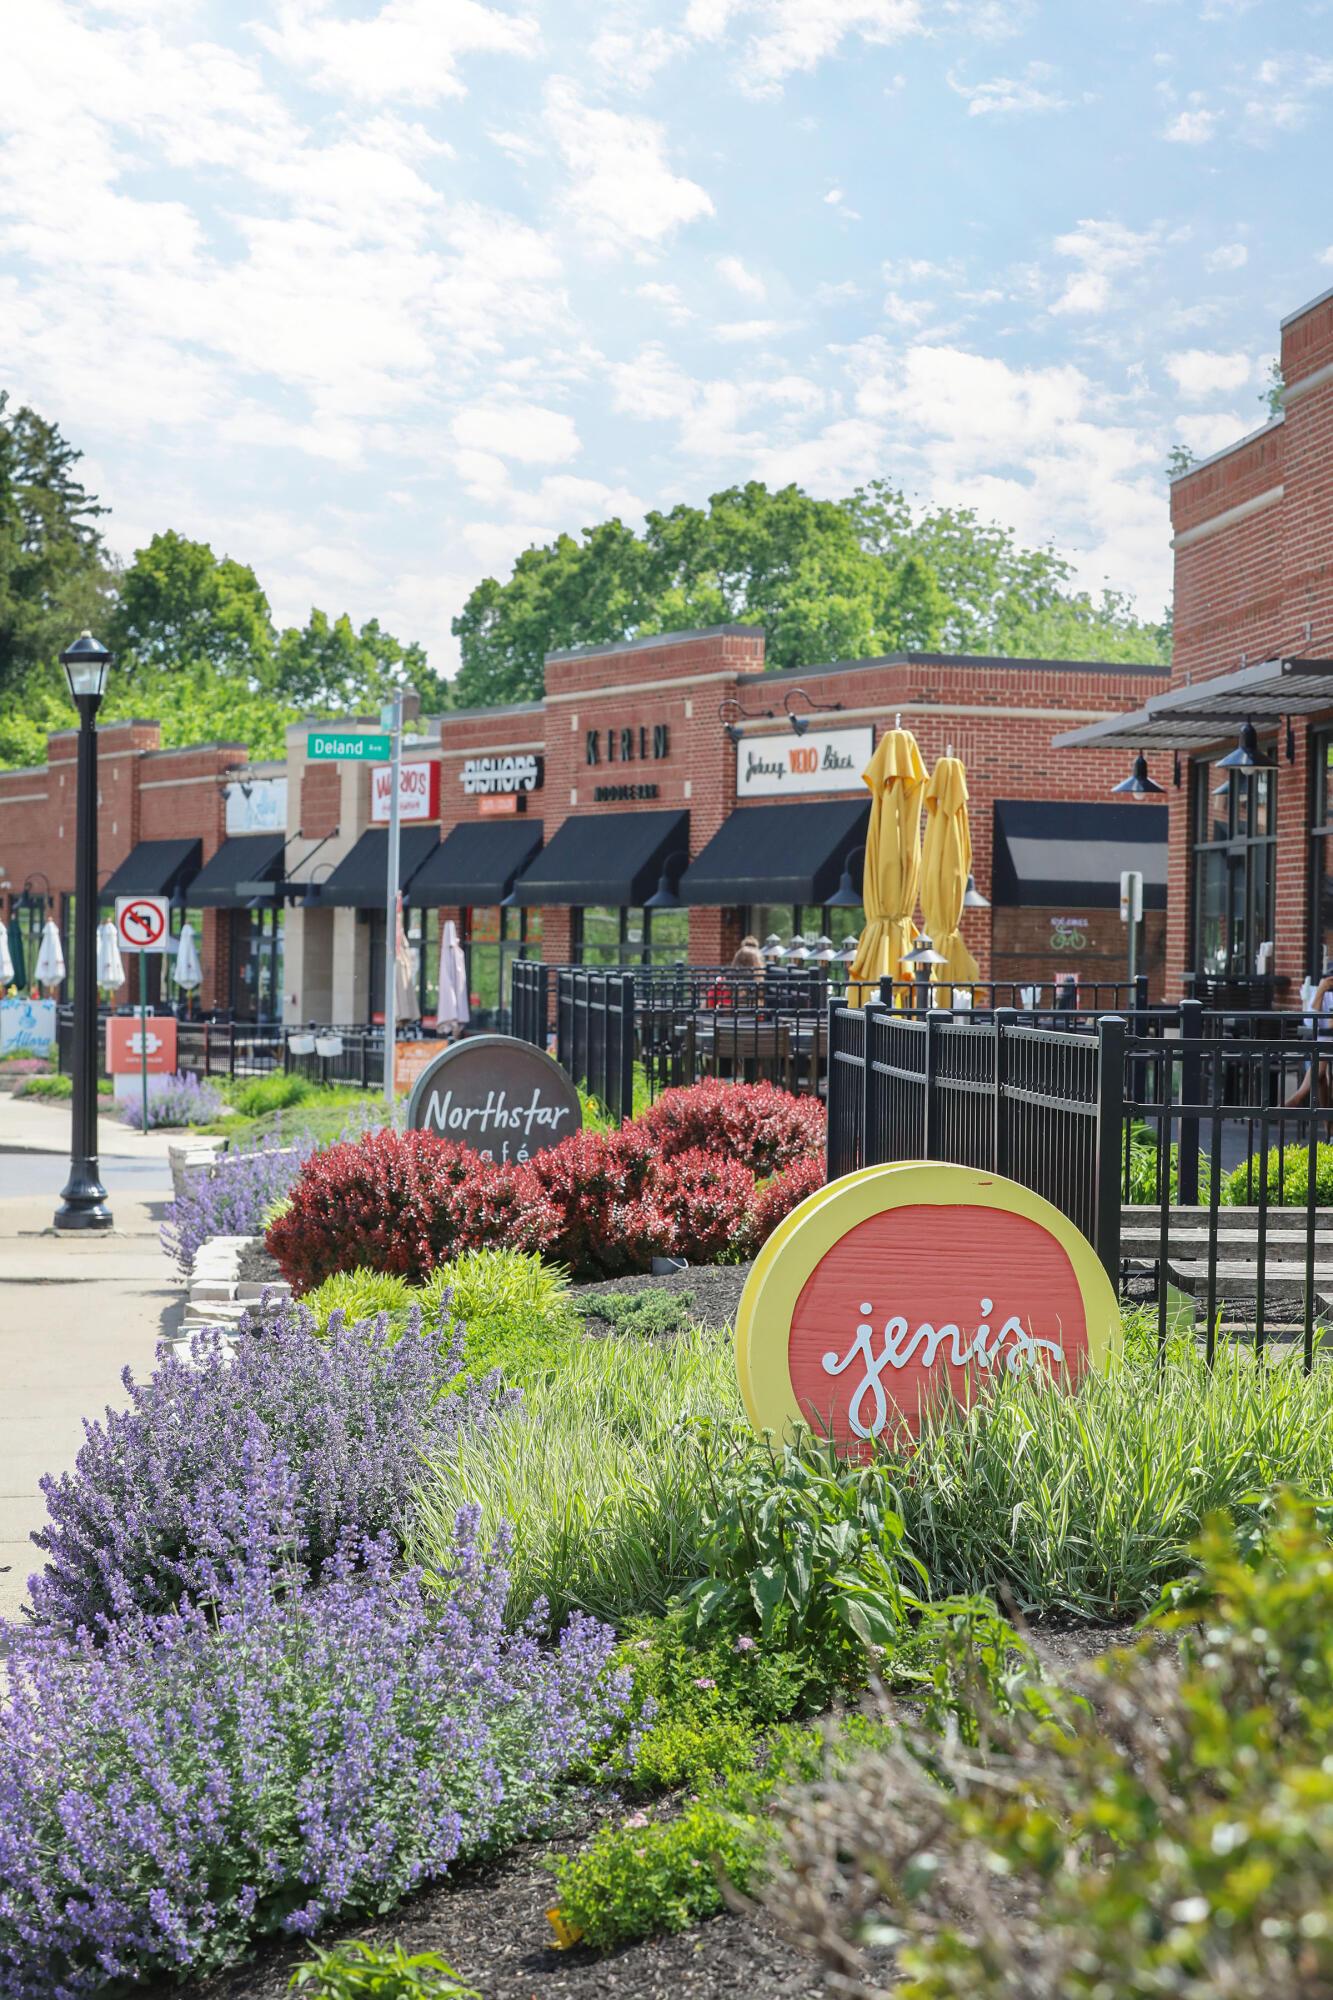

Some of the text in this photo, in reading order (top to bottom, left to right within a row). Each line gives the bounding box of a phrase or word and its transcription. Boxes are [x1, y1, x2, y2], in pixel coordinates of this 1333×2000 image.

[314, 738, 364, 755] Deland
[586, 724, 669, 766] KIRIN
[745, 744, 854, 783] Johnny VELO Bikes
[464, 755, 537, 794] BISHOPS
[424, 1088, 570, 1135] Northstar
[479, 1141, 529, 1164] afé
[822, 1298, 1065, 1439] jeni's
